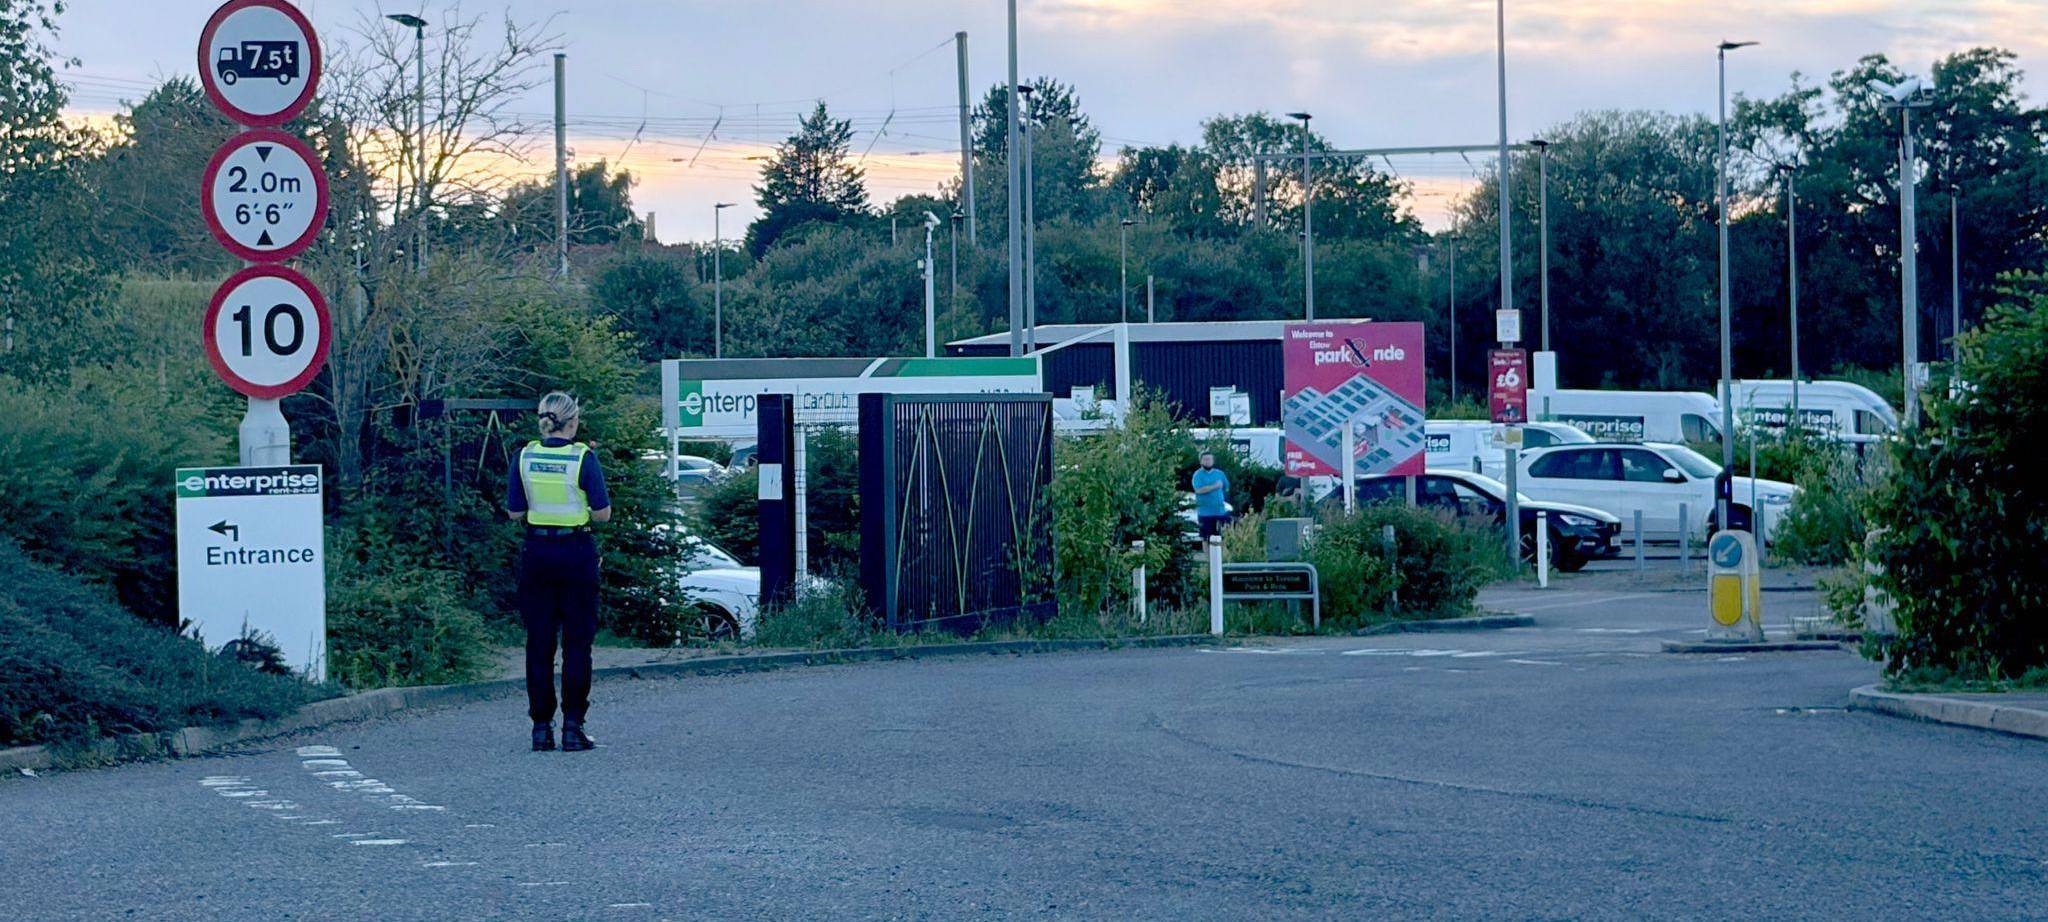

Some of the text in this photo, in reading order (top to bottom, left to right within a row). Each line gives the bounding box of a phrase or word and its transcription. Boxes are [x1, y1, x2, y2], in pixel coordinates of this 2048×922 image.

[246, 45, 293, 70] 7.5t
[228, 166, 302, 194] 2.0m
[232, 302, 305, 357] 10
[1291, 330, 1334, 339] Welcome to
[1315, 345, 1350, 366] park
[184, 470, 318, 493] enterprise
[268, 486, 318, 495] rent-a-car
[206, 546, 314, 566] Entrance
